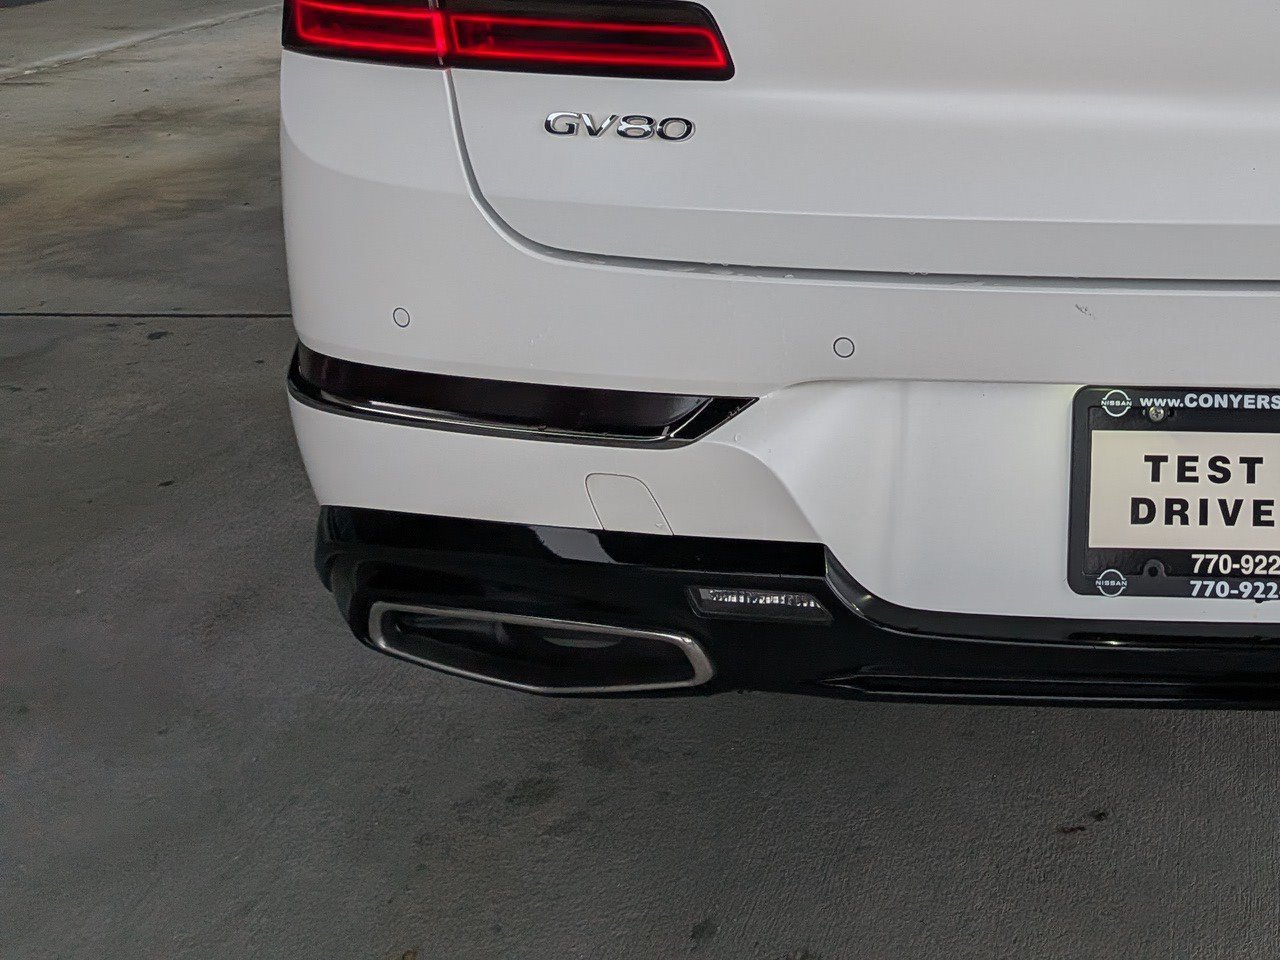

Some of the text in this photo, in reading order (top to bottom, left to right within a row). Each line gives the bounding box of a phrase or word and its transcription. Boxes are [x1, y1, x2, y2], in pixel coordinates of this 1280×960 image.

[544, 111, 696, 142] GV80
[1101, 399, 1132, 407] NISSAN
[1143, 455, 1264, 485] TEST
[1130, 497, 1275, 527] DRIVE
[1095, 579, 1128, 587] NISSAN
